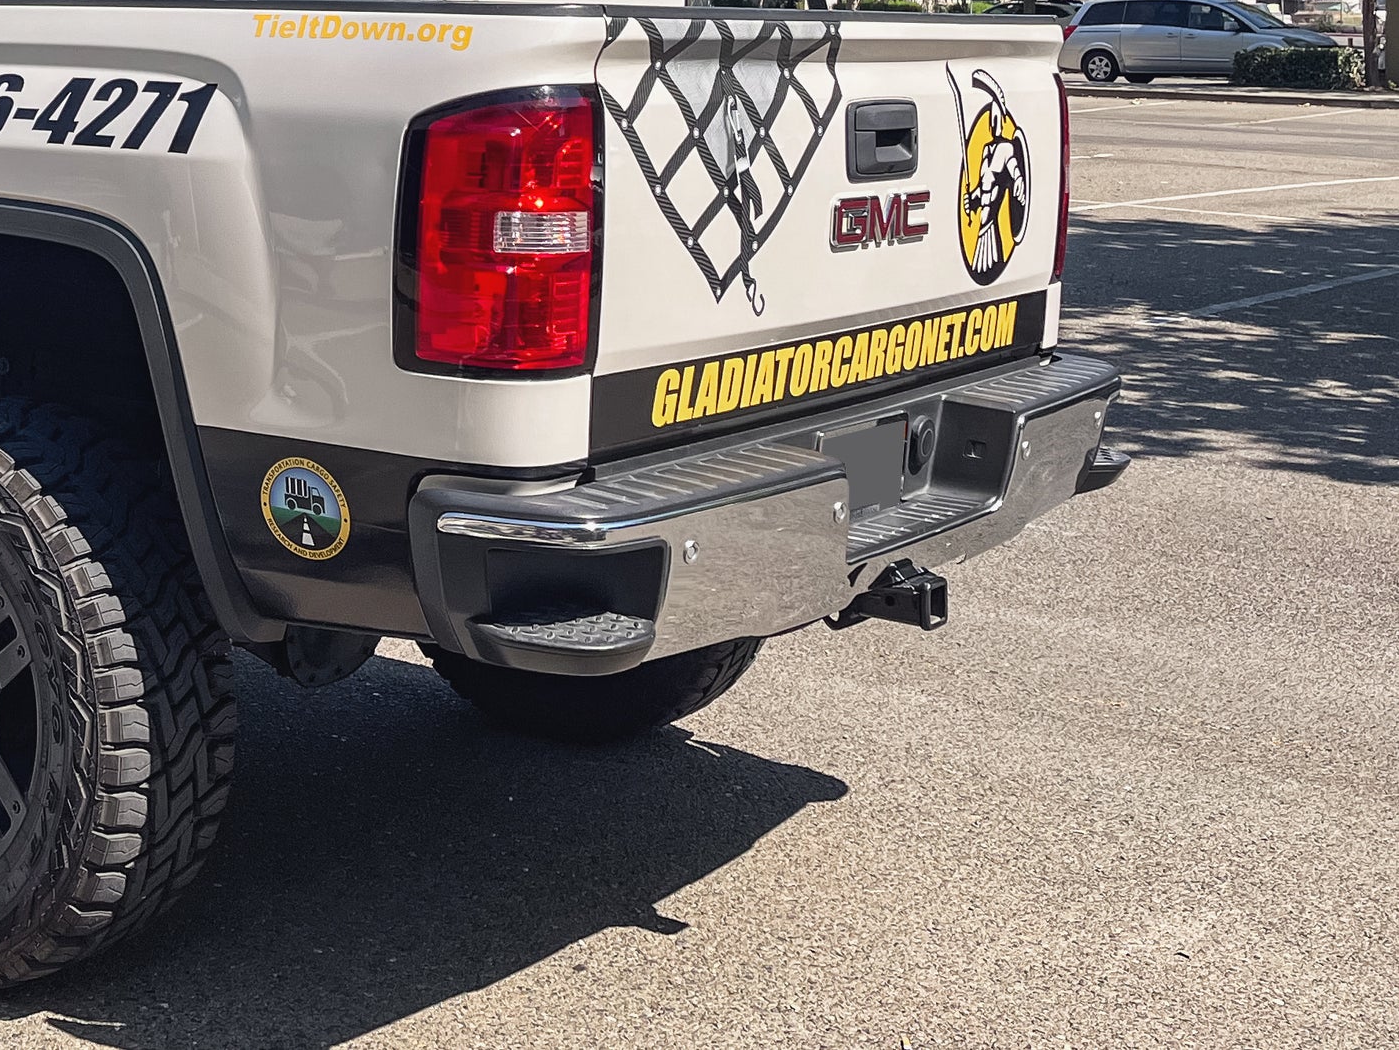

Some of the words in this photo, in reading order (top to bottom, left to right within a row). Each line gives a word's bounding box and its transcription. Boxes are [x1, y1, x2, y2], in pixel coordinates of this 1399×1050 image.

[251, 14, 473, 50] TieItDown.org
[830, 189, 931, 253] GMC
[651, 300, 1018, 428] GLADIATORCARGONET.COM
[262, 458, 305, 495] TRANSPORTATION
[306, 461, 329, 480] CARGO
[328, 477, 346, 508] SAFETY
[266, 517, 293, 550] RESEARCH
[293, 547, 308, 557] AND
[308, 537, 345, 559] DEVELOPMENT
